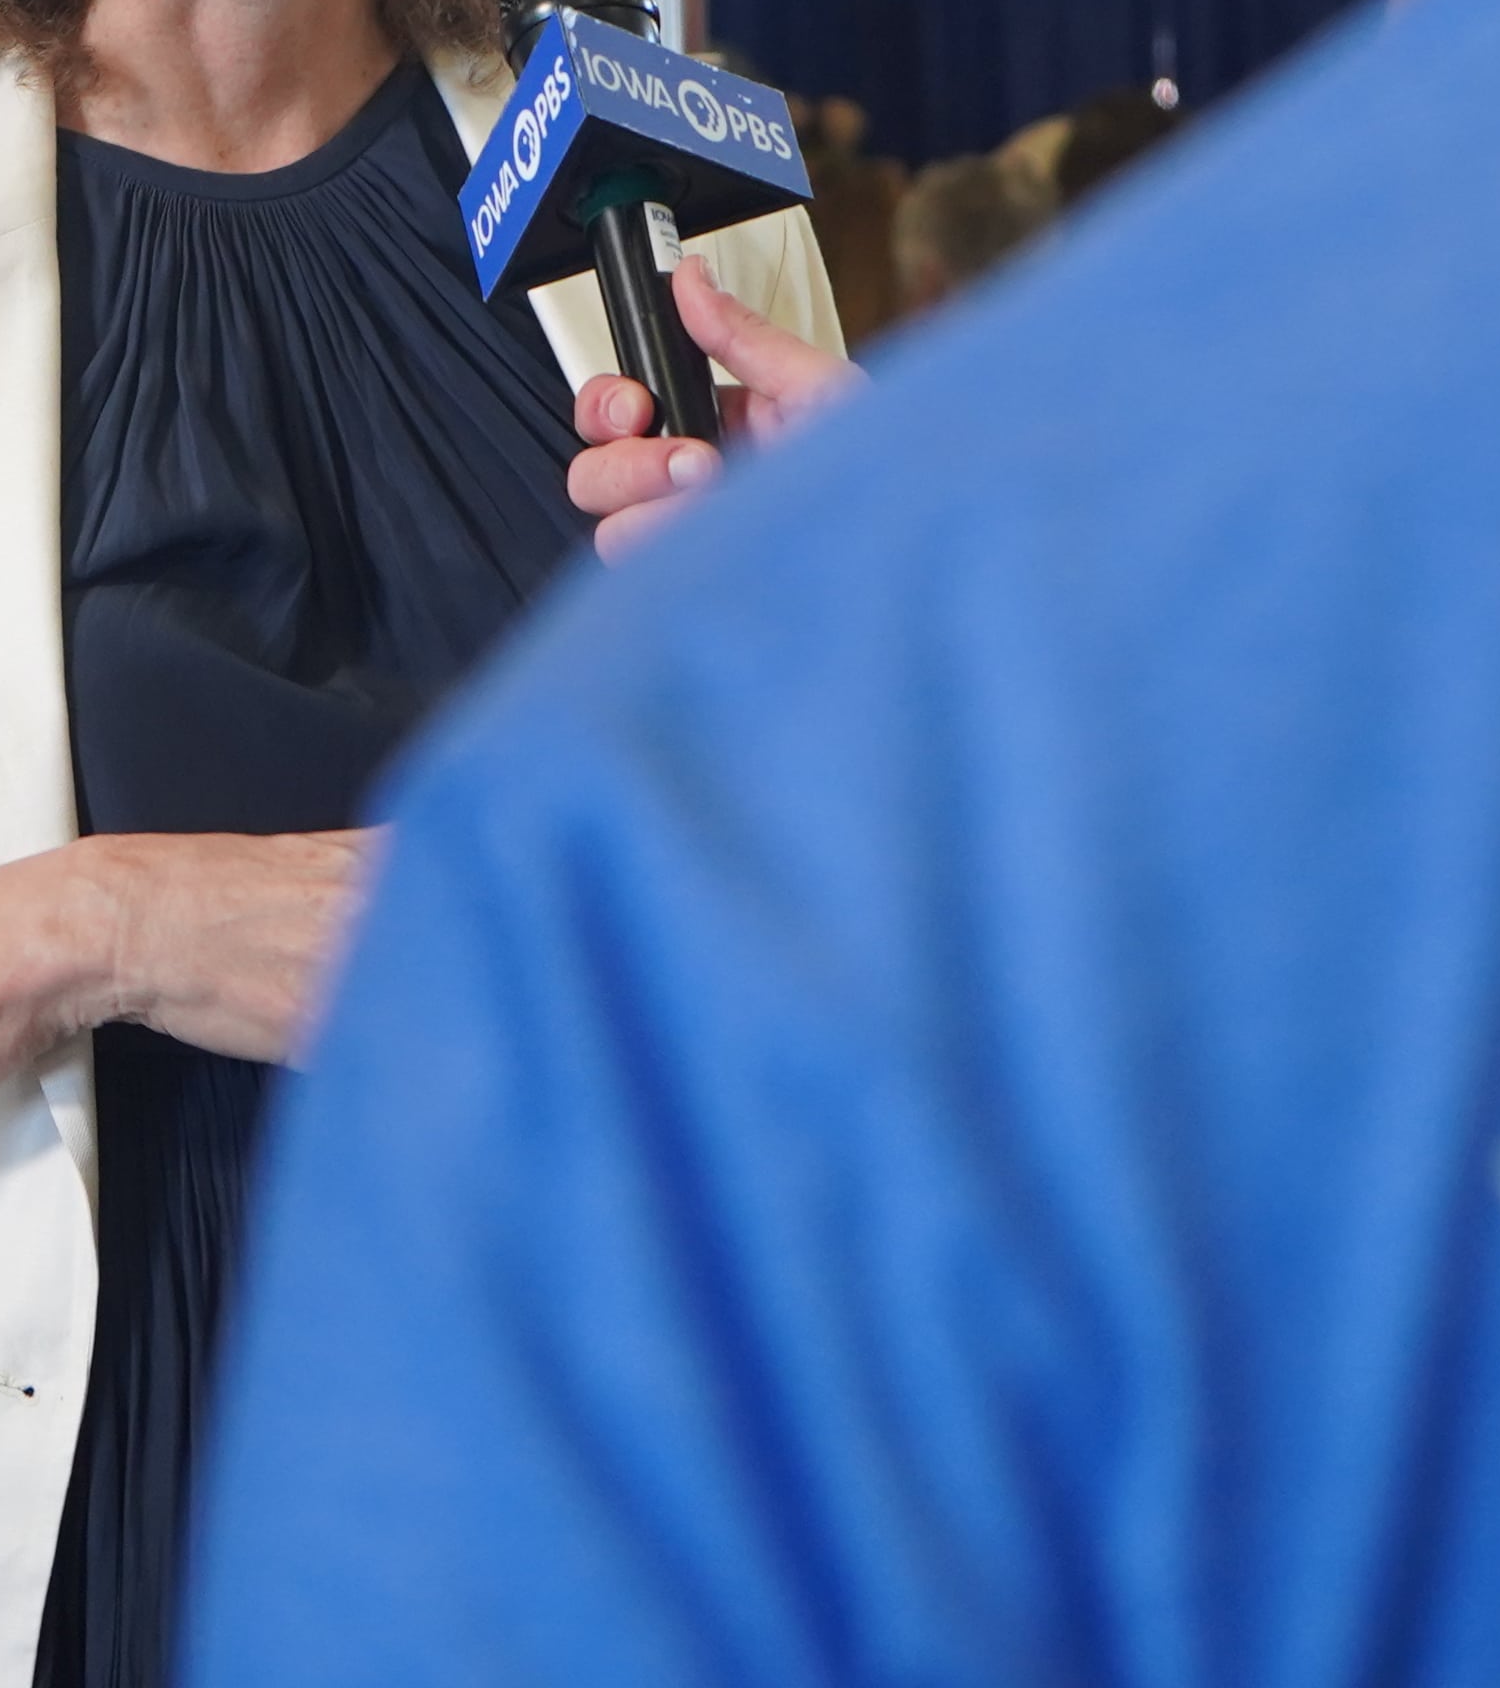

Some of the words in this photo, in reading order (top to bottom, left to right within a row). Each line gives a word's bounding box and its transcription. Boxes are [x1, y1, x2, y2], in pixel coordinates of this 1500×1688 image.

[471, 160, 520, 259] IOWA
[534, 55, 571, 139] PBS
[580, 47, 680, 118] IOWA
[725, 103, 793, 161] PBS
